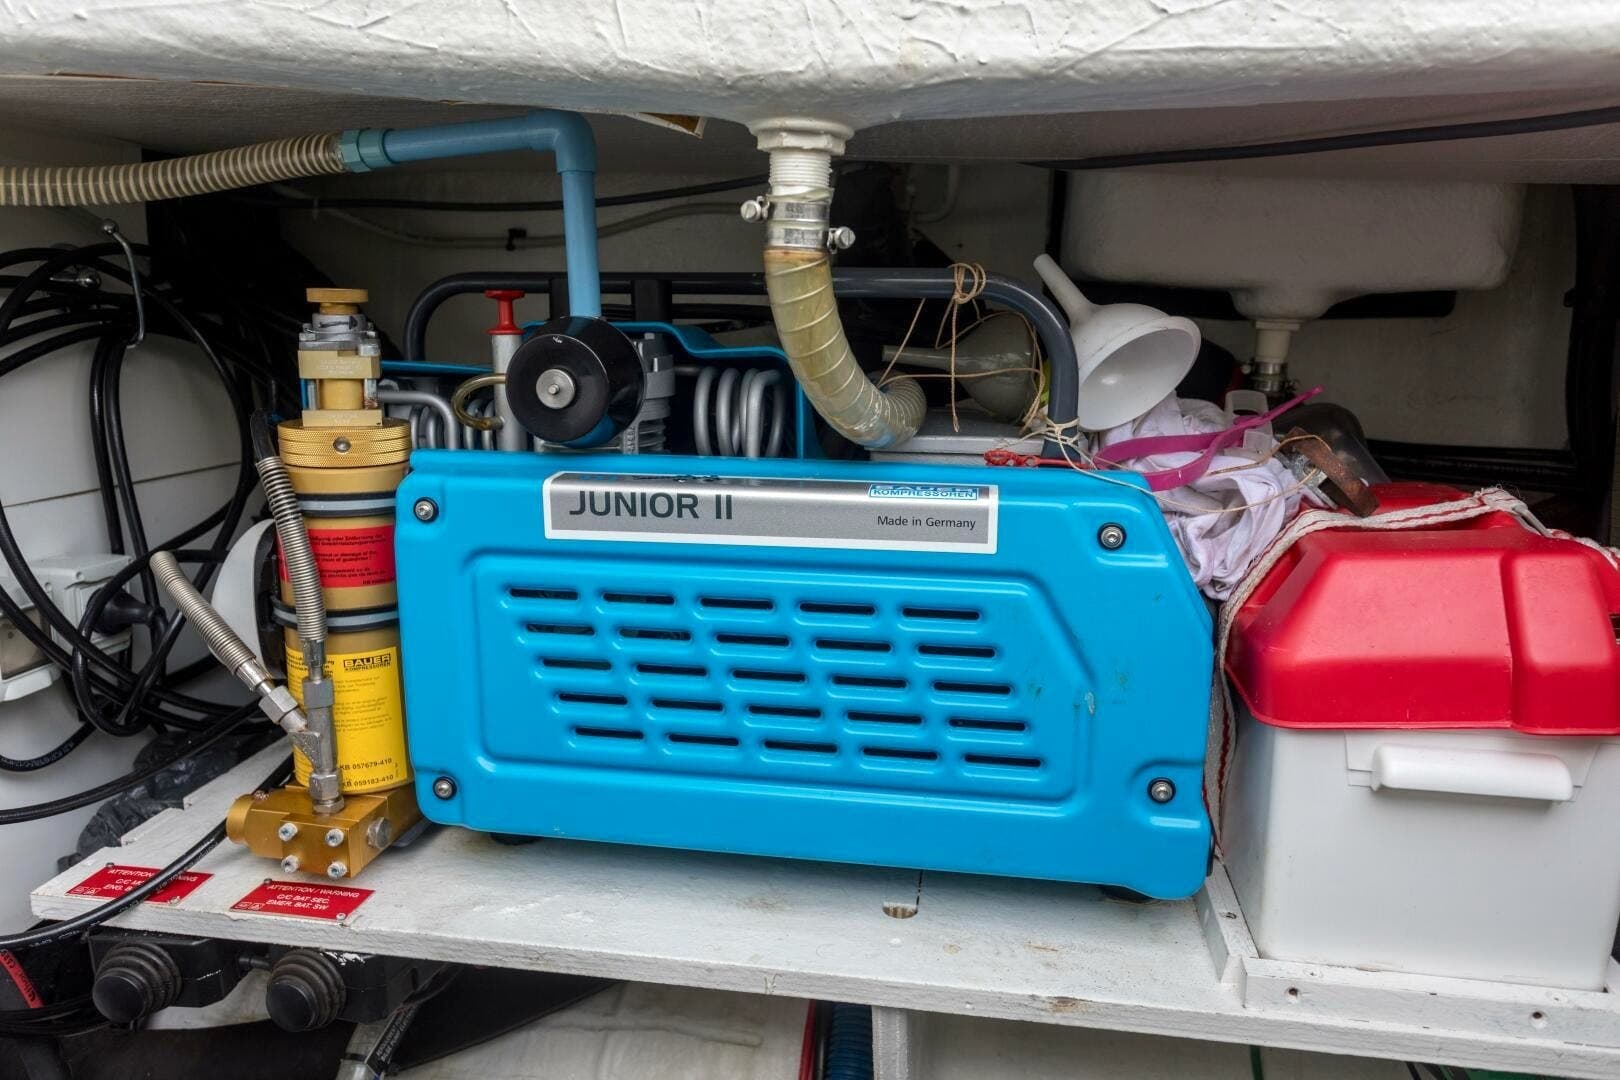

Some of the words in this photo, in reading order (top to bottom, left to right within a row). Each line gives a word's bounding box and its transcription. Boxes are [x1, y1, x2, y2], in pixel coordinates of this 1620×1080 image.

[569, 490, 699, 519] JUNIOR
[715, 494, 733, 520] II
[877, 515, 909, 526] Made
[912, 516, 922, 527] in
[926, 517, 977, 531] Germany
[344, 653, 391, 668] BAUER
[108, 868, 156, 878] ATTENTION
[267, 884, 316, 894] ATTENTION
[319, 889, 361, 898] WARNING
